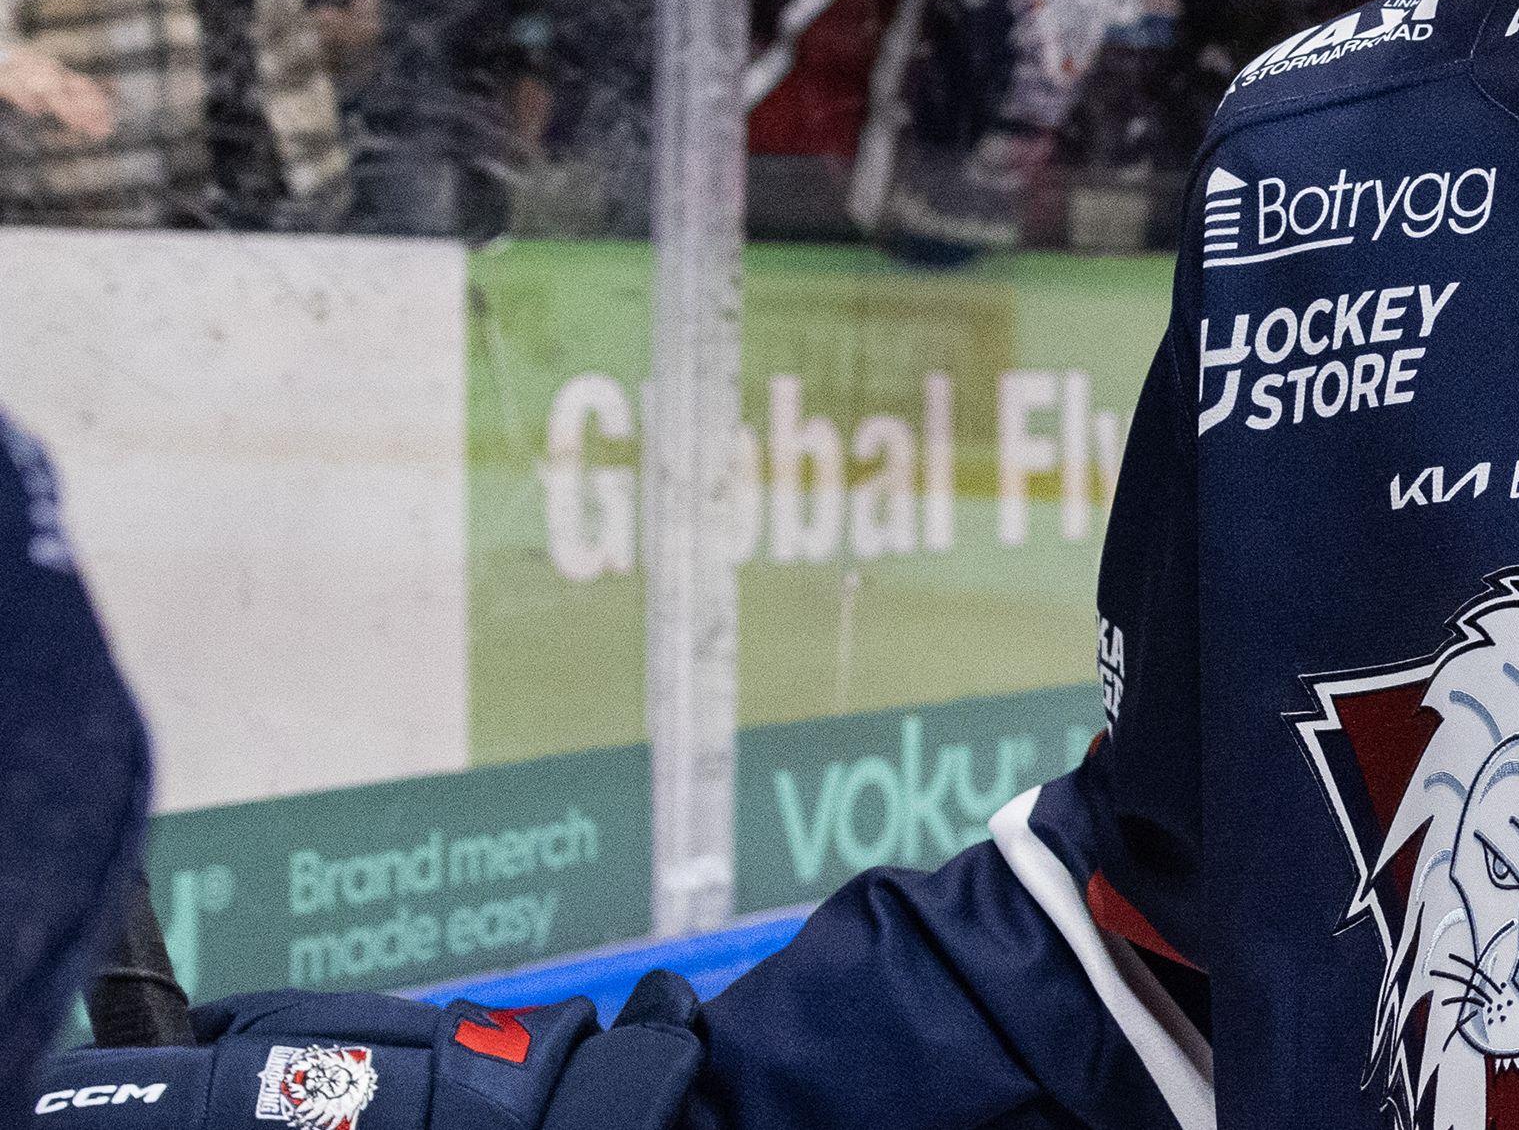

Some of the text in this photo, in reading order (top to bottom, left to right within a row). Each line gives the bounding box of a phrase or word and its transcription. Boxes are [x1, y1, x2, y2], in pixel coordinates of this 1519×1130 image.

[1257, 167, 1497, 244] Botrygg
[1198, 282, 1461, 398] HOCKEY
[1245, 347, 1426, 431] STORE
[1390, 461, 1492, 511] KIA
[289, 805, 599, 914] Brand merch
[289, 903, 440, 987] made
[447, 889, 561, 956] easy
[34, 1083, 167, 1116] CCM
